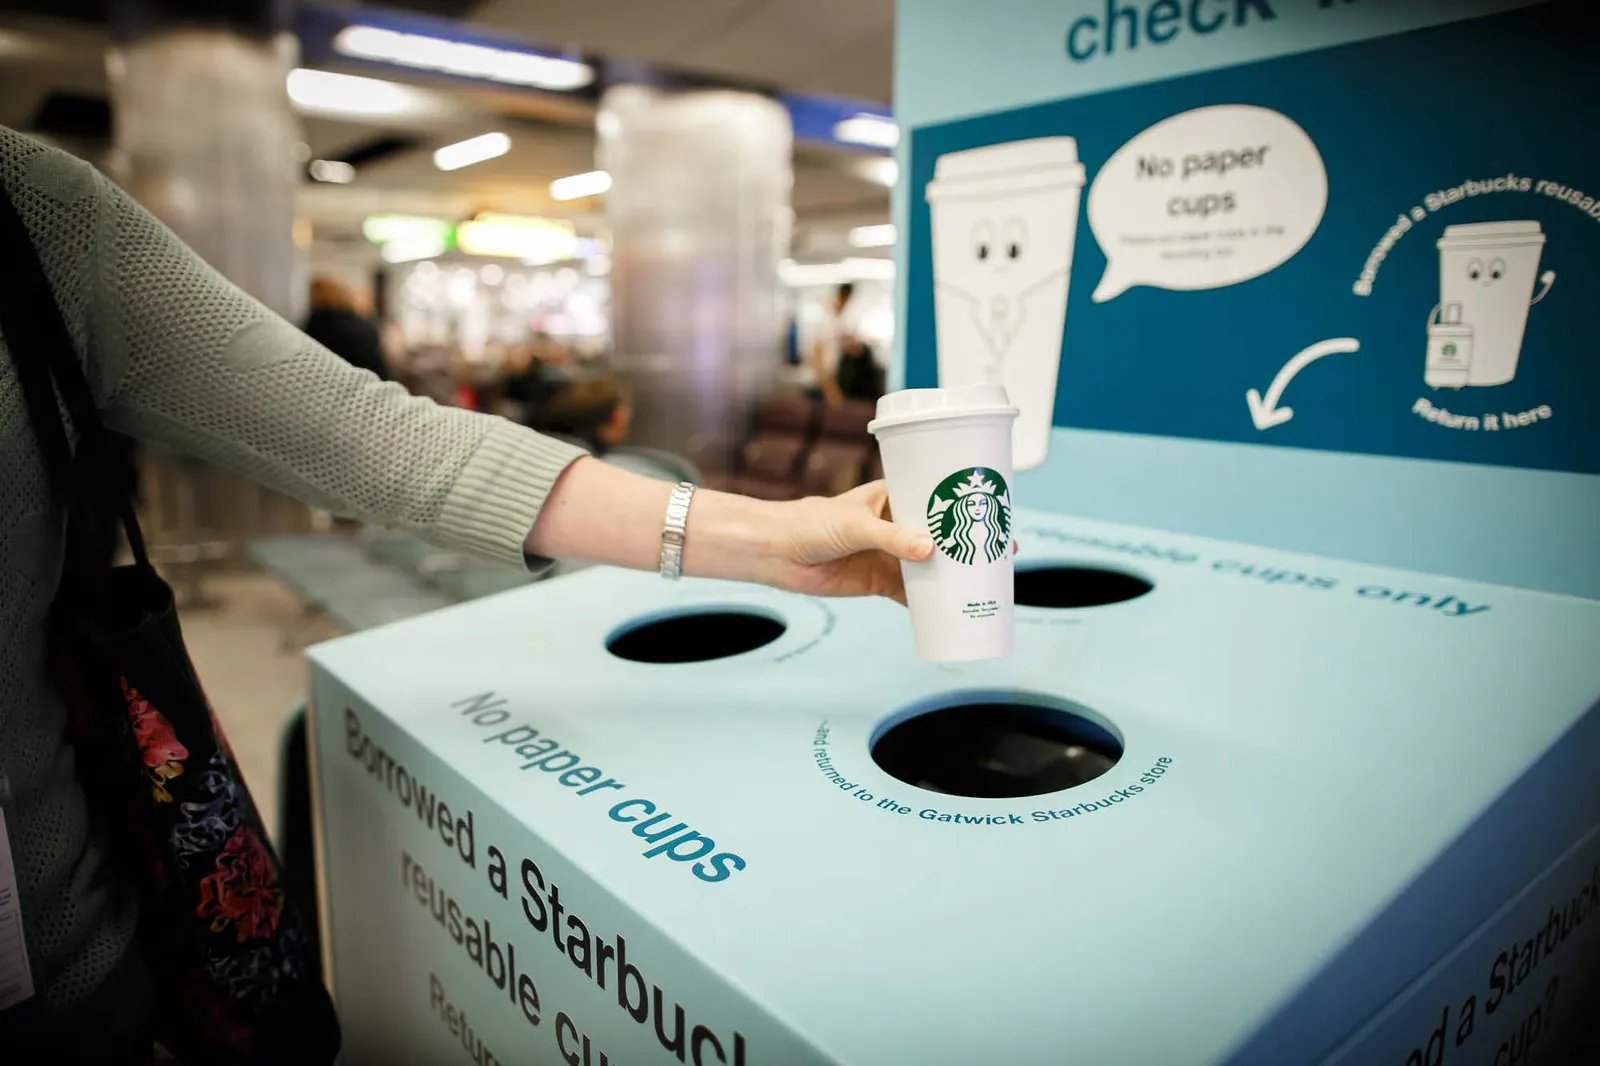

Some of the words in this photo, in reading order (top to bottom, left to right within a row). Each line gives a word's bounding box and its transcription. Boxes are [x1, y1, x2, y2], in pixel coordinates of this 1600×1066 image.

[1136, 153, 1175, 180] No
[1182, 146, 1270, 181] paper
[1166, 193, 1237, 217] cups
[1424, 173, 1532, 211] Starbucks
[1534, 178, 1600, 223] reusab
[1411, 397, 1479, 431] Return
[1484, 413, 1499, 431] it
[1502, 404, 1552, 430] here
[1212, 560, 1339, 590] cups
[1356, 585, 1492, 617] only
[451, 691, 512, 727] No
[482, 724, 626, 796] paper
[608, 799, 746, 883] cups
[813, 748, 859, 791] returned
[853, 788, 874, 802] to
[876, 797, 912, 815] the
[919, 807, 1024, 825] Gatwick
[1033, 783, 1143, 822] Starbucks
[1140, 755, 1173, 785] store
[345, 707, 475, 869] Borrowed
[487, 845, 508, 899] a
[520, 858, 746, 1066] Starbuc
[402, 850, 541, 1026] reusable
[430, 971, 503, 1066] Retur
[1456, 995, 1476, 1047] a
